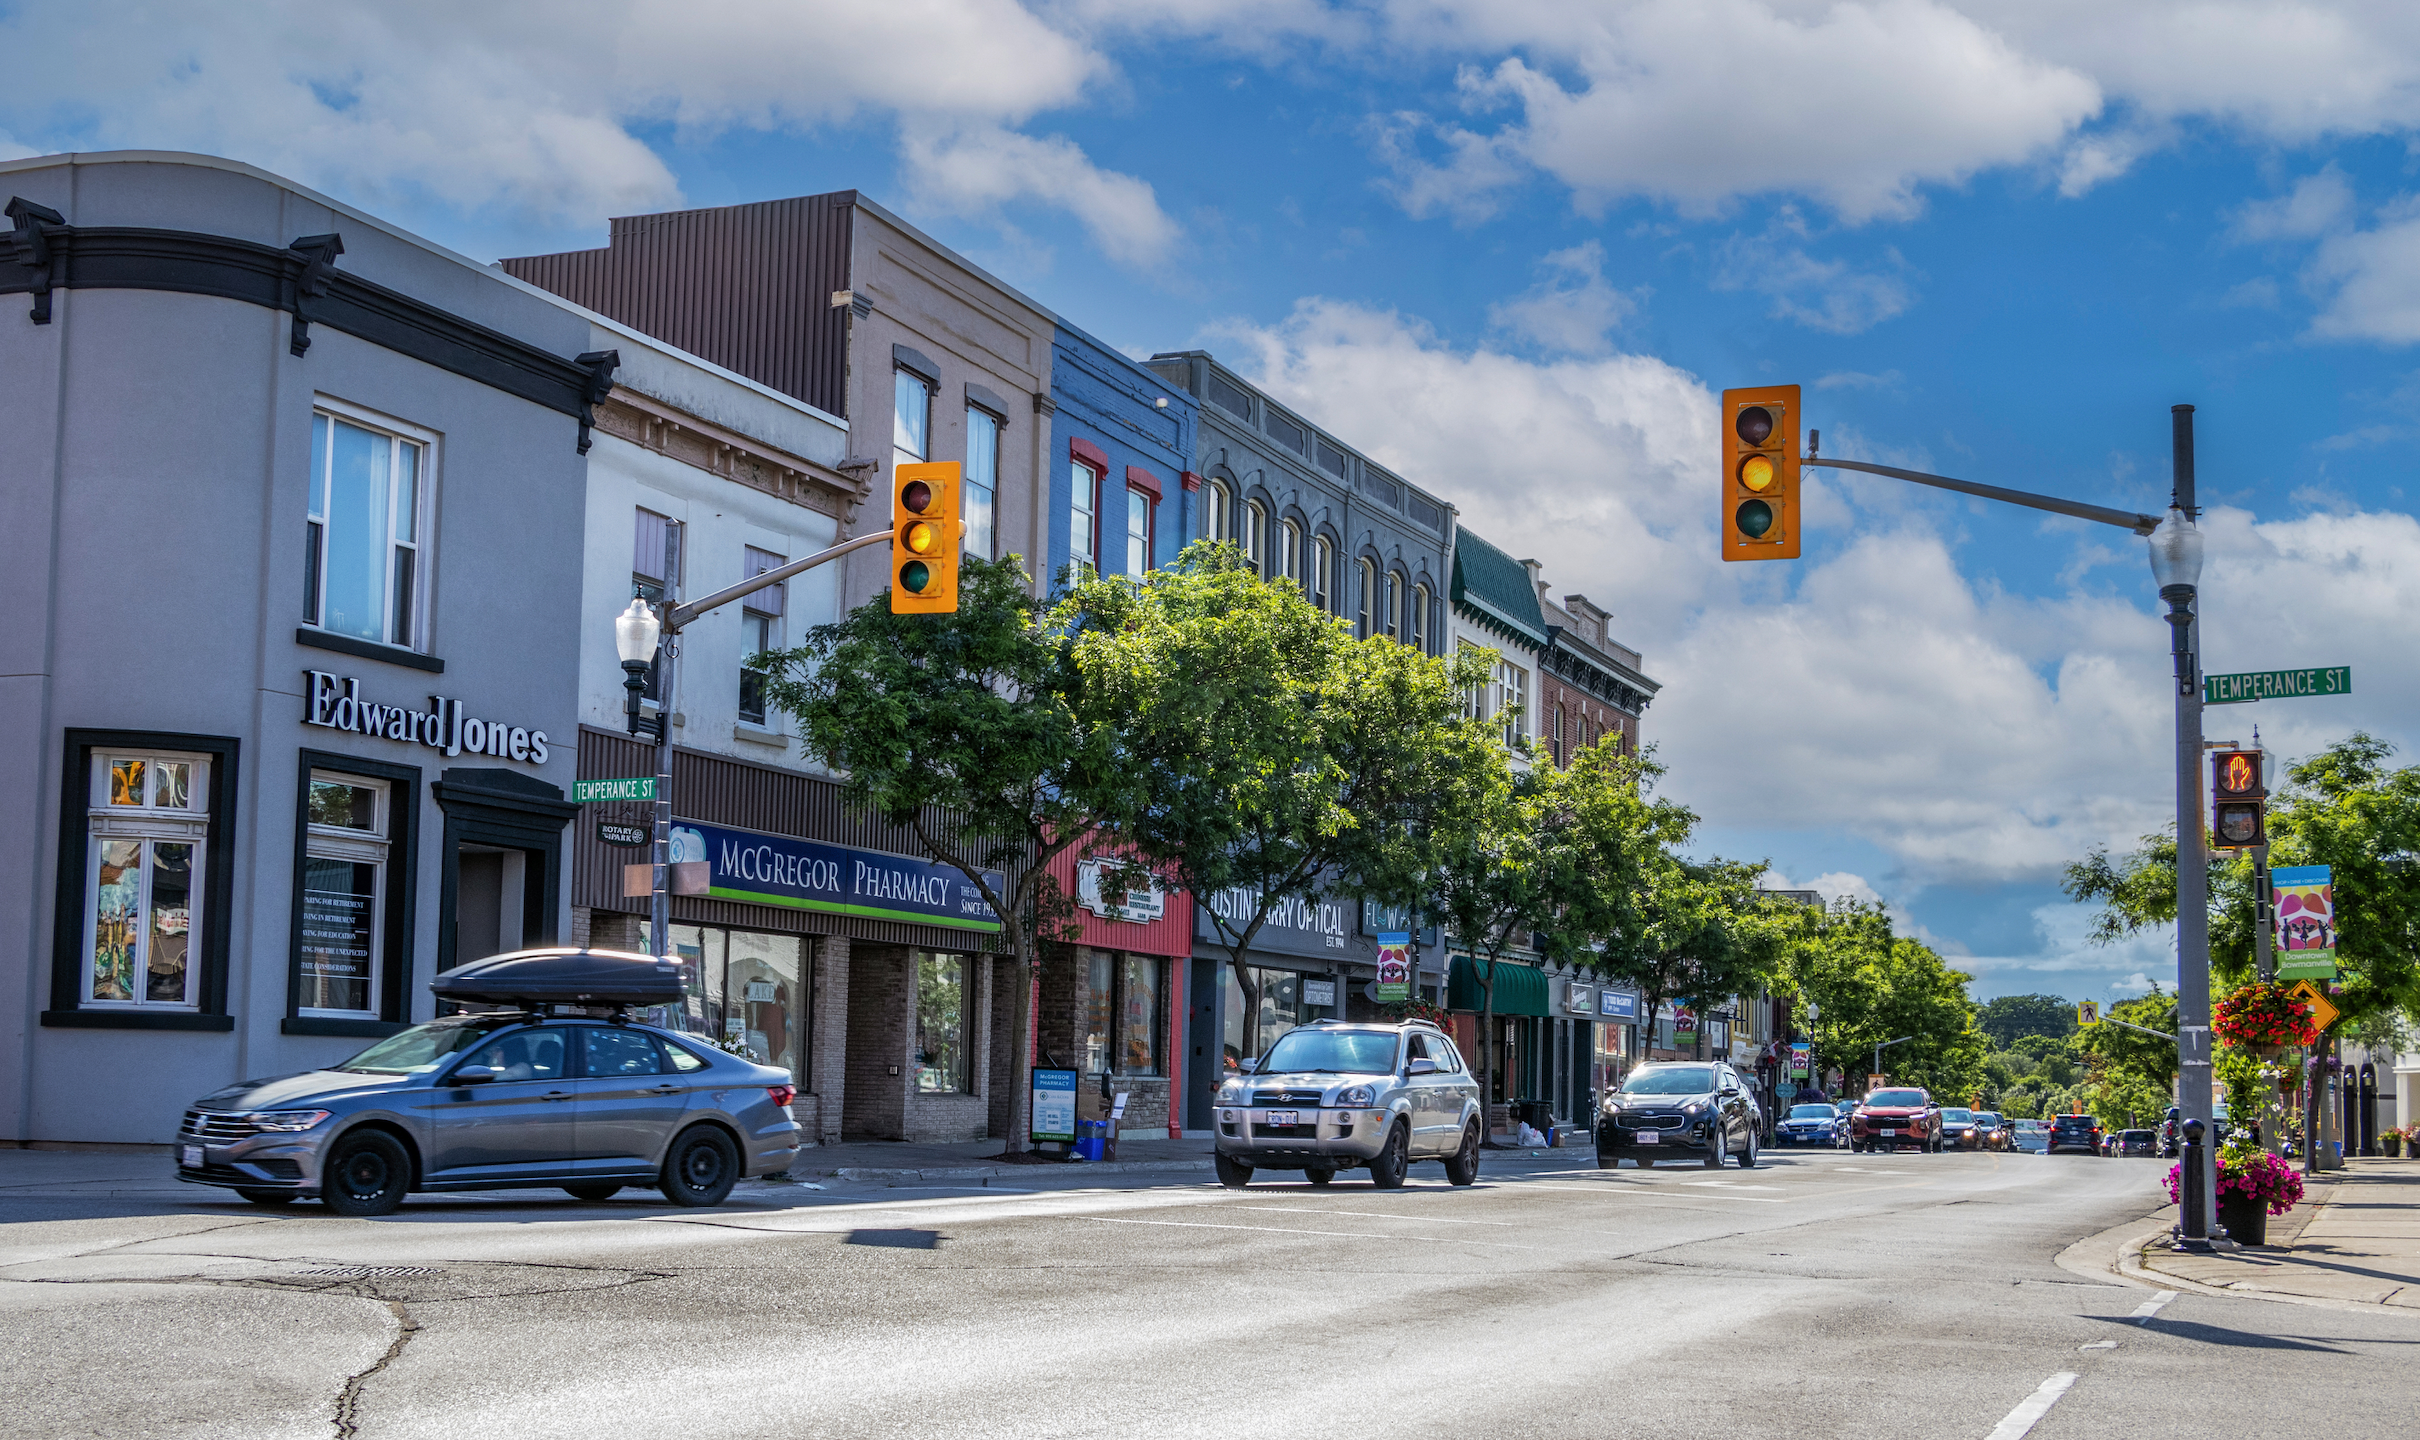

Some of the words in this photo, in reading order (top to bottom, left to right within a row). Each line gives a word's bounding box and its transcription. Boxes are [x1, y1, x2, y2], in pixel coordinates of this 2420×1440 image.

[2210, 671, 2317, 699] TEMPERANCE
[2326, 669, 2344, 692] ST
[577, 781, 637, 800] TEMPERANCE
[642, 780, 653, 797] ST
[602, 825, 633, 835] ROTARY
[854, 860, 950, 907] PHARMACY
[1129, 893, 1151, 902] CHINESE
[960, 898, 981, 915] SINCE
[1129, 901, 1160, 912] RESTAURANT
[304, 912, 318, 920] IVING
[1297, 899, 1344, 936] OPTICAL
[328, 932, 356, 940] EDUCATION
[2285, 952, 2328, 960] Downtown
[2282, 960, 2332, 968] Bowmanville
